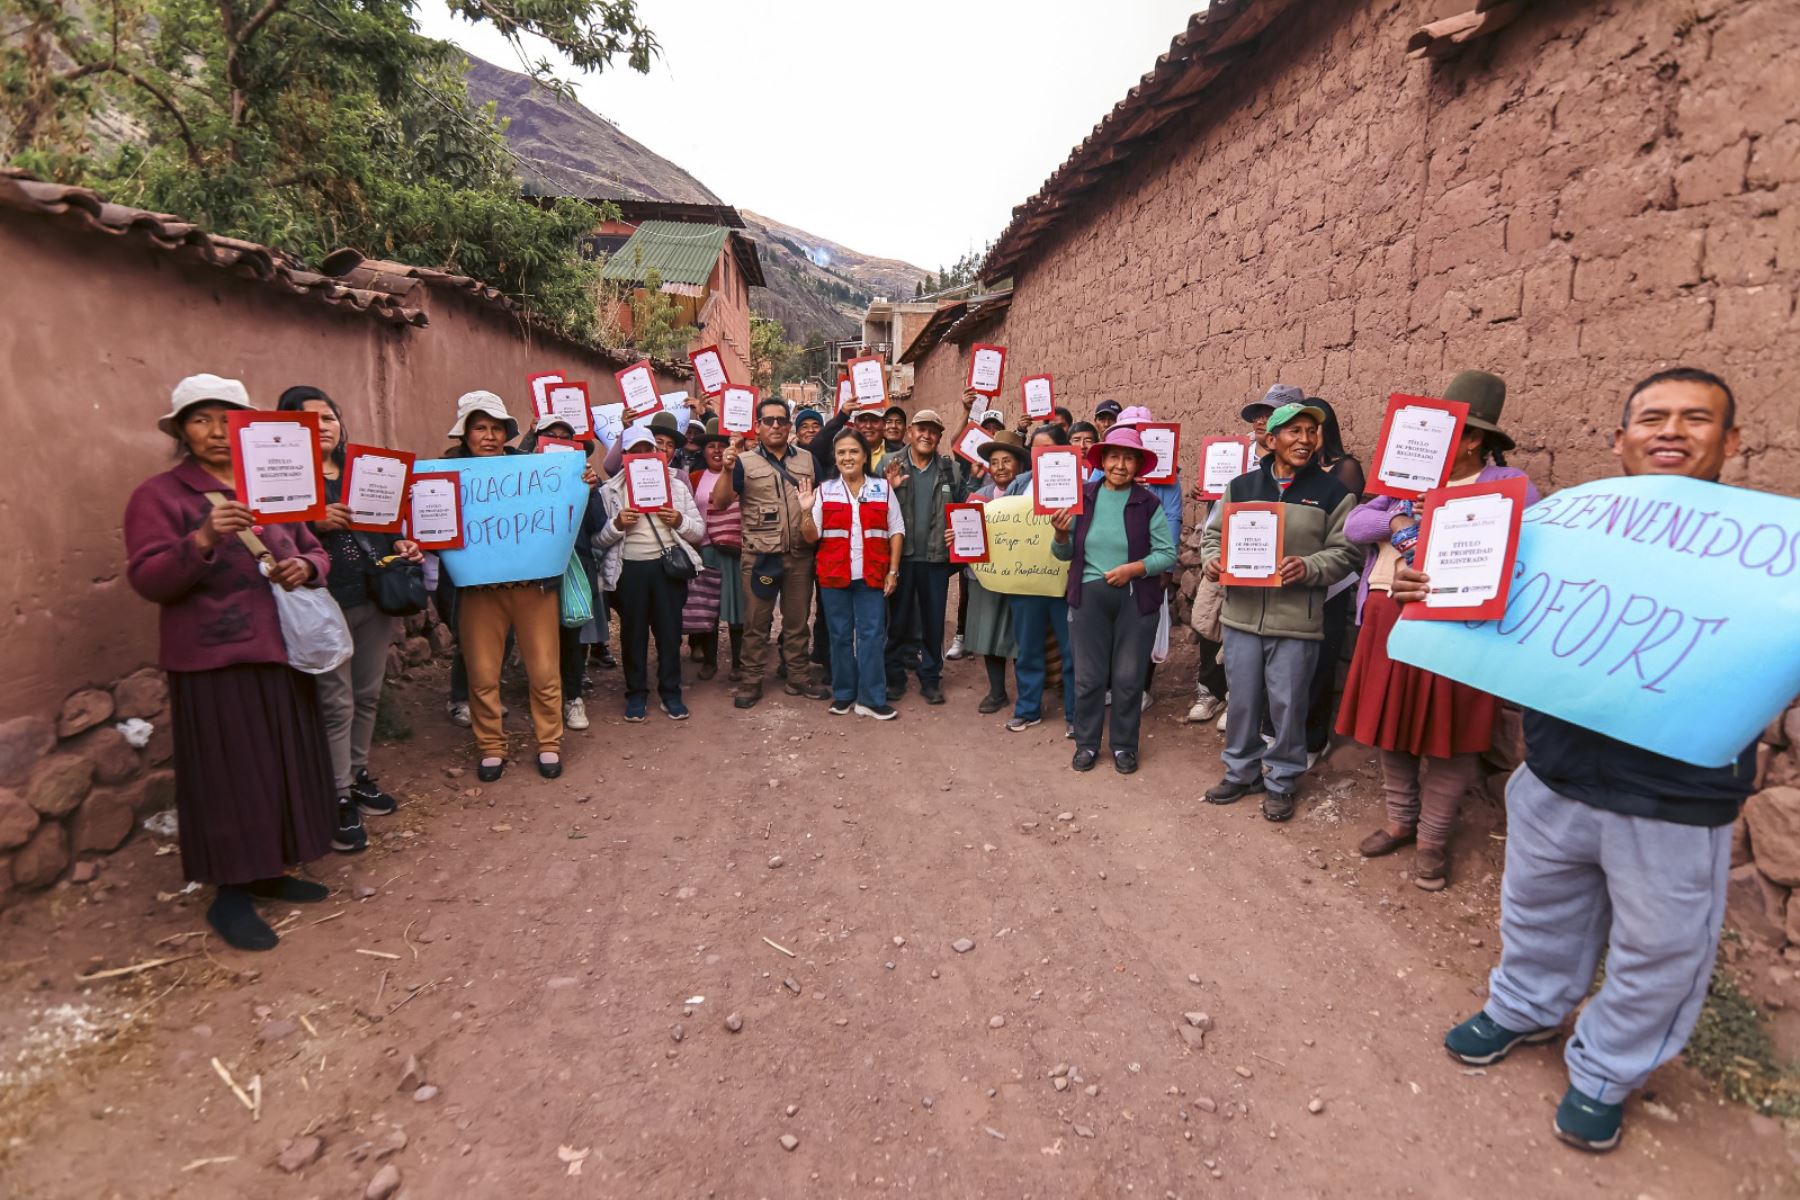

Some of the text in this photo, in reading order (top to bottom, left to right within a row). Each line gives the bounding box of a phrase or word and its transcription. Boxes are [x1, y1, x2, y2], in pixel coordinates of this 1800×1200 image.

[464, 506, 555, 548] OFOPRI
[1522, 493, 1800, 577] BIENVENIDOS
[1450, 547, 1493, 557] PROPIEDAD
[1440, 556, 1489, 565] REGISTRADO
[1014, 561, 1061, 576] Propiedad
